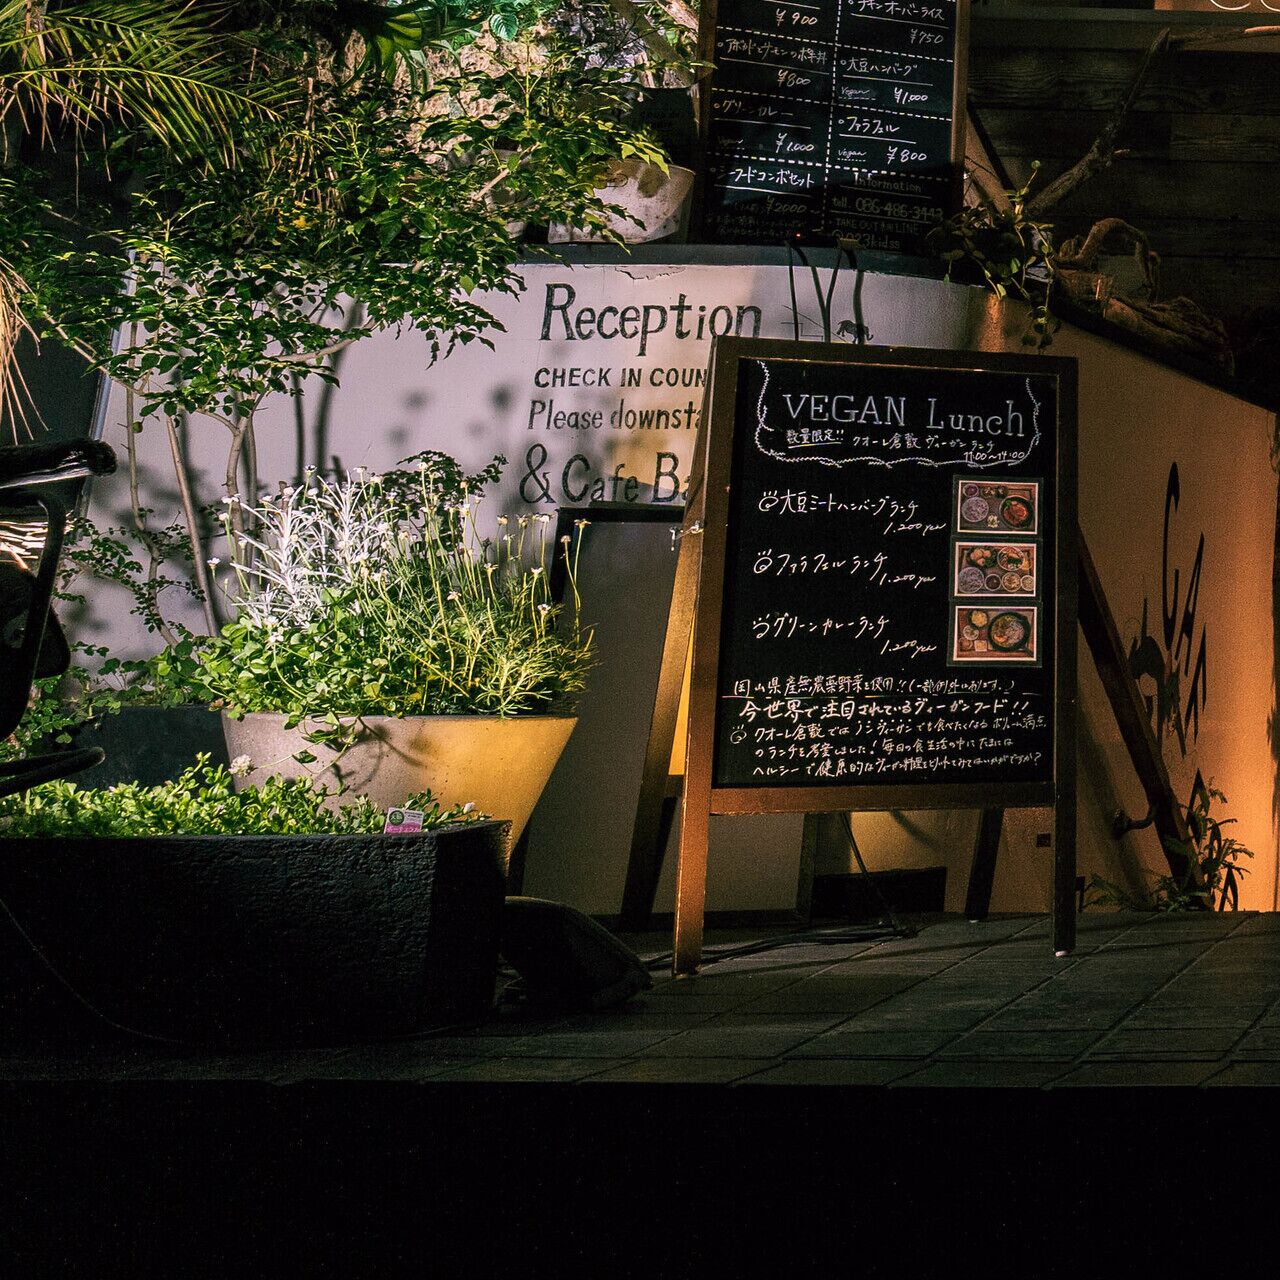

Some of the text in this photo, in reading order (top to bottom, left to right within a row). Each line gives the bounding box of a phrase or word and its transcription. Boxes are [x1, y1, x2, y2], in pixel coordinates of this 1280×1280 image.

[776, 8, 818, 26] ¥900
[910, 28, 944, 44] ¥750
[849, 58, 918, 77] 大豆ハンバーグ
[778, 69, 811, 87] ¥800
[846, 116, 900, 135] ファラフェル
[887, 146, 927, 164] ¥800
[539, 282, 763, 357] Reception
[534, 367, 610, 388] CHECK
[620, 367, 641, 387] IN
[528, 400, 603, 430] Please
[782, 394, 1025, 437] VEGAN Lunch
[519, 443, 557, 504] &
[561, 453, 639, 504] Cafe
